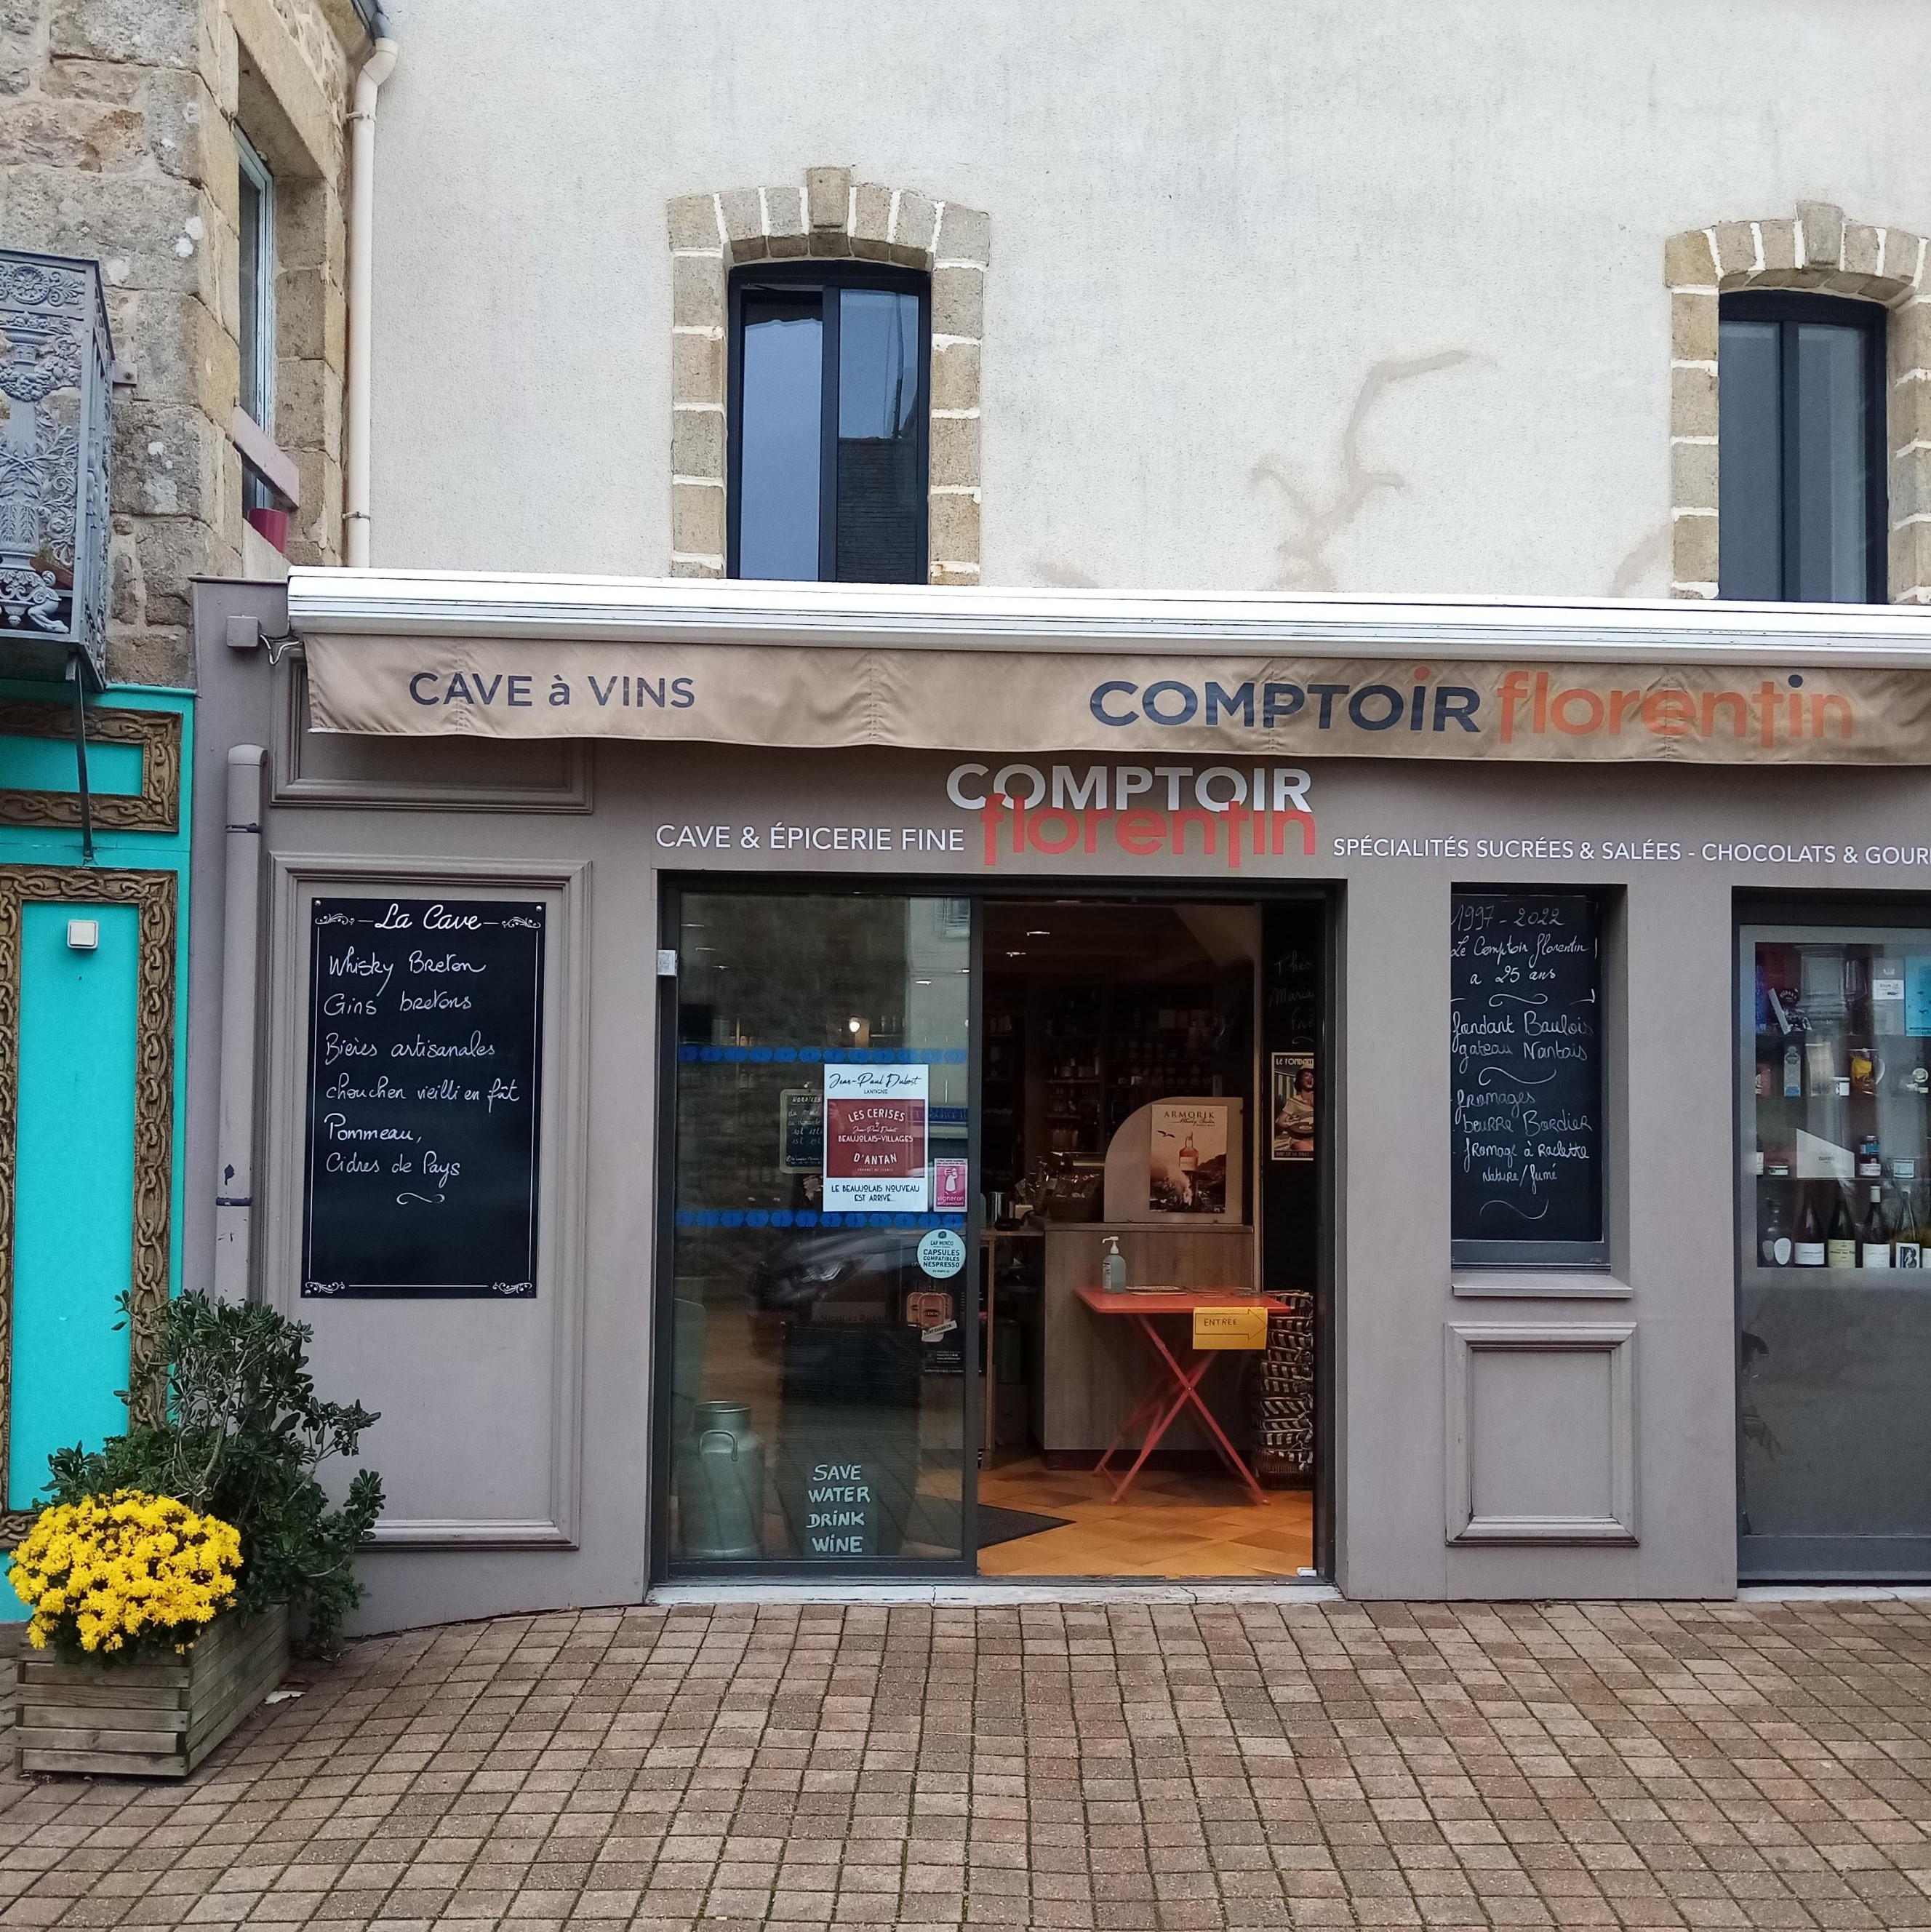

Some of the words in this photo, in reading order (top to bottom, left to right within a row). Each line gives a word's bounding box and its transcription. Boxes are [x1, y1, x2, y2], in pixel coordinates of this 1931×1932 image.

[409, 672, 532, 706] CAVE
[548, 674, 570, 706] à
[587, 676, 695, 708] VINS
[1497, 671, 1852, 749] florentin
[946, 764, 1312, 813] COMPTOIR
[656, 825, 731, 849] CAVE
[740, 826, 761, 849] &
[770, 822, 892, 850] ÉPICERIE
[902, 829, 964, 851] FINE
[980, 793, 1316, 868] florentin
[1333, 835, 1469, 858] SPÉCIALITÉS
[1476, 837, 1573, 859] SUCRÉES
[1580, 842, 1595, 860] &
[1602, 839, 1681, 861] SALÉES
[1702, 843, 1836, 863] CHOCOLATS
[1843, 846, 1858, 864] &
[1865, 846, 1931, 865] GOUR
[375, 903, 412, 930] La
[423, 904, 482, 930] Cave
[1451, 904, 1495, 931] 1997
[1514, 907, 1565, 927] 2022
[1450, 935, 1470, 957] Le
[1474, 935, 1529, 965] Comptoir
[329, 946, 394, 997] Whisky
[409, 950, 486, 974] Breton
[1495, 965, 1521, 983] 25
[1529, 968, 1557, 981] ans
[324, 994, 377, 1015] Gins
[399, 990, 472, 1011] bretons
[1524, 1010, 1594, 1037] Baulois
[391, 1030, 495, 1058] artisanales
[1523, 1040, 1588, 1061] Nantais
[417, 1079, 461, 1101] vieilli
[464, 1090, 480, 1101] en
[848, 1110, 865, 1122] LES
[867, 1108, 905, 1122] CERISES
[838, 1135, 913, 1143] BEAUJOLAIS-VILLAGES
[1524, 1140, 1534, 1157] à
[326, 1151, 380, 1173] Cidres
[391, 1154, 412, 1174] de
[423, 1150, 460, 1188] Pays
[853, 1153, 897, 1165] D'ANTAN
[831, 1185, 839, 1193] LE
[842, 1184, 883, 1193] BEAUJOLAIS
[886, 1185, 920, 1193] NOUVEAU
[1204, 1317, 1238, 1327] ENTRÉE
[812, 1464, 862, 1481] SAVE
[808, 1486, 871, 1503] WATER
